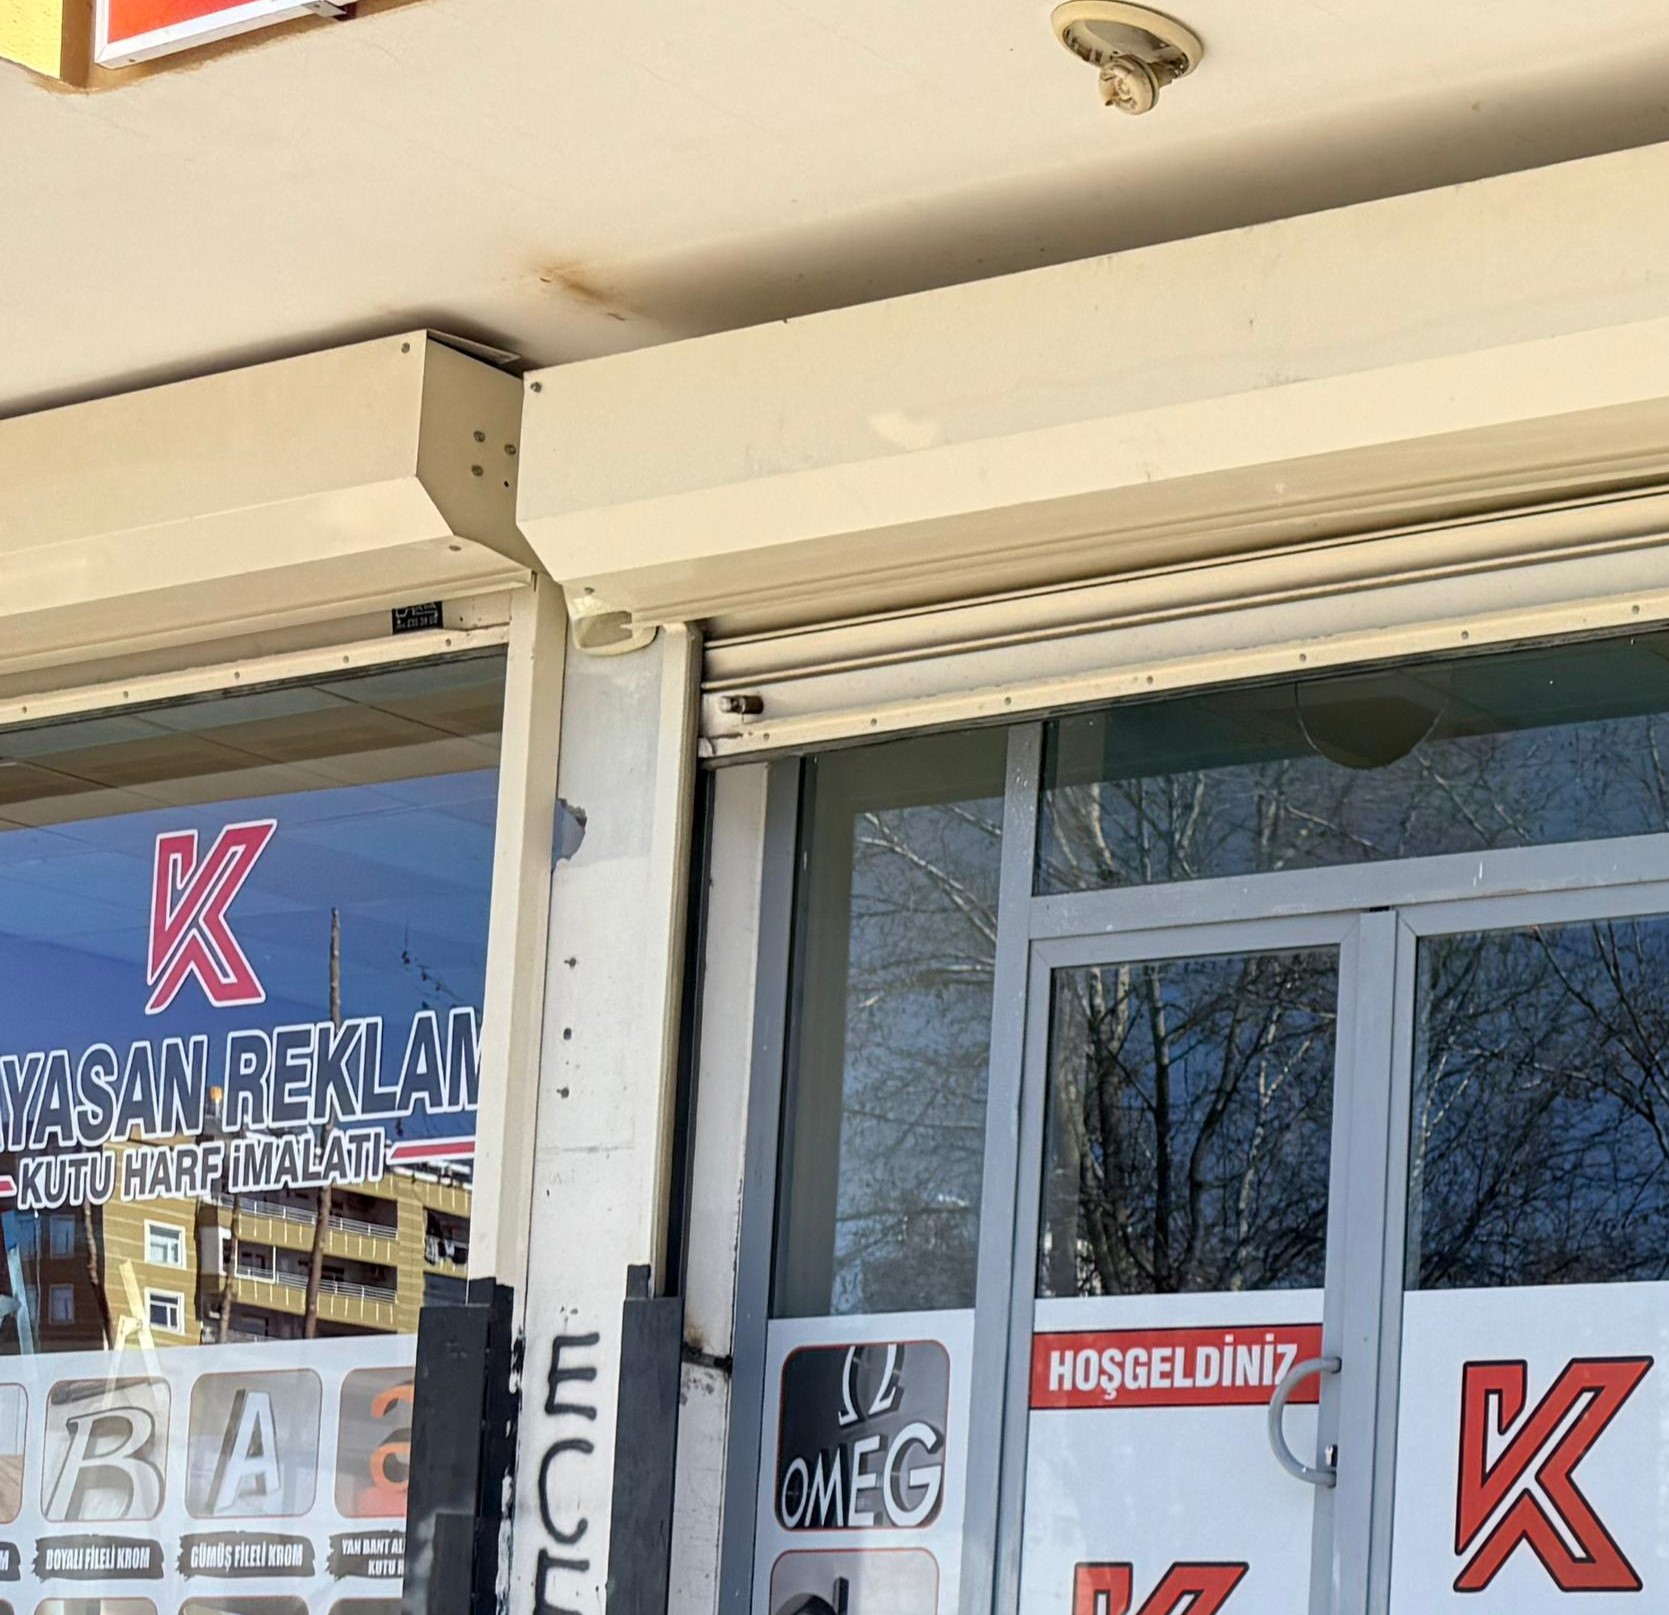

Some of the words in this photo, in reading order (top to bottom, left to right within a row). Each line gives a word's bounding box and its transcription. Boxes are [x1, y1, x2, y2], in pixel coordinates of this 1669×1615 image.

[0, 1034, 209, 1152] YASAN
[18, 1153, 115, 1210] KUTU
[122, 1140, 224, 1199] HARF
[1048, 1332, 1299, 1399] HOŞGELDİNİZ
[782, 1422, 942, 1528] OMEG
[46, 1548, 82, 1571] BOYALI
[117, 1546, 151, 1569] KROM
[268, 1543, 304, 1568] KROM
[368, 1560, 396, 1576] KUTU
